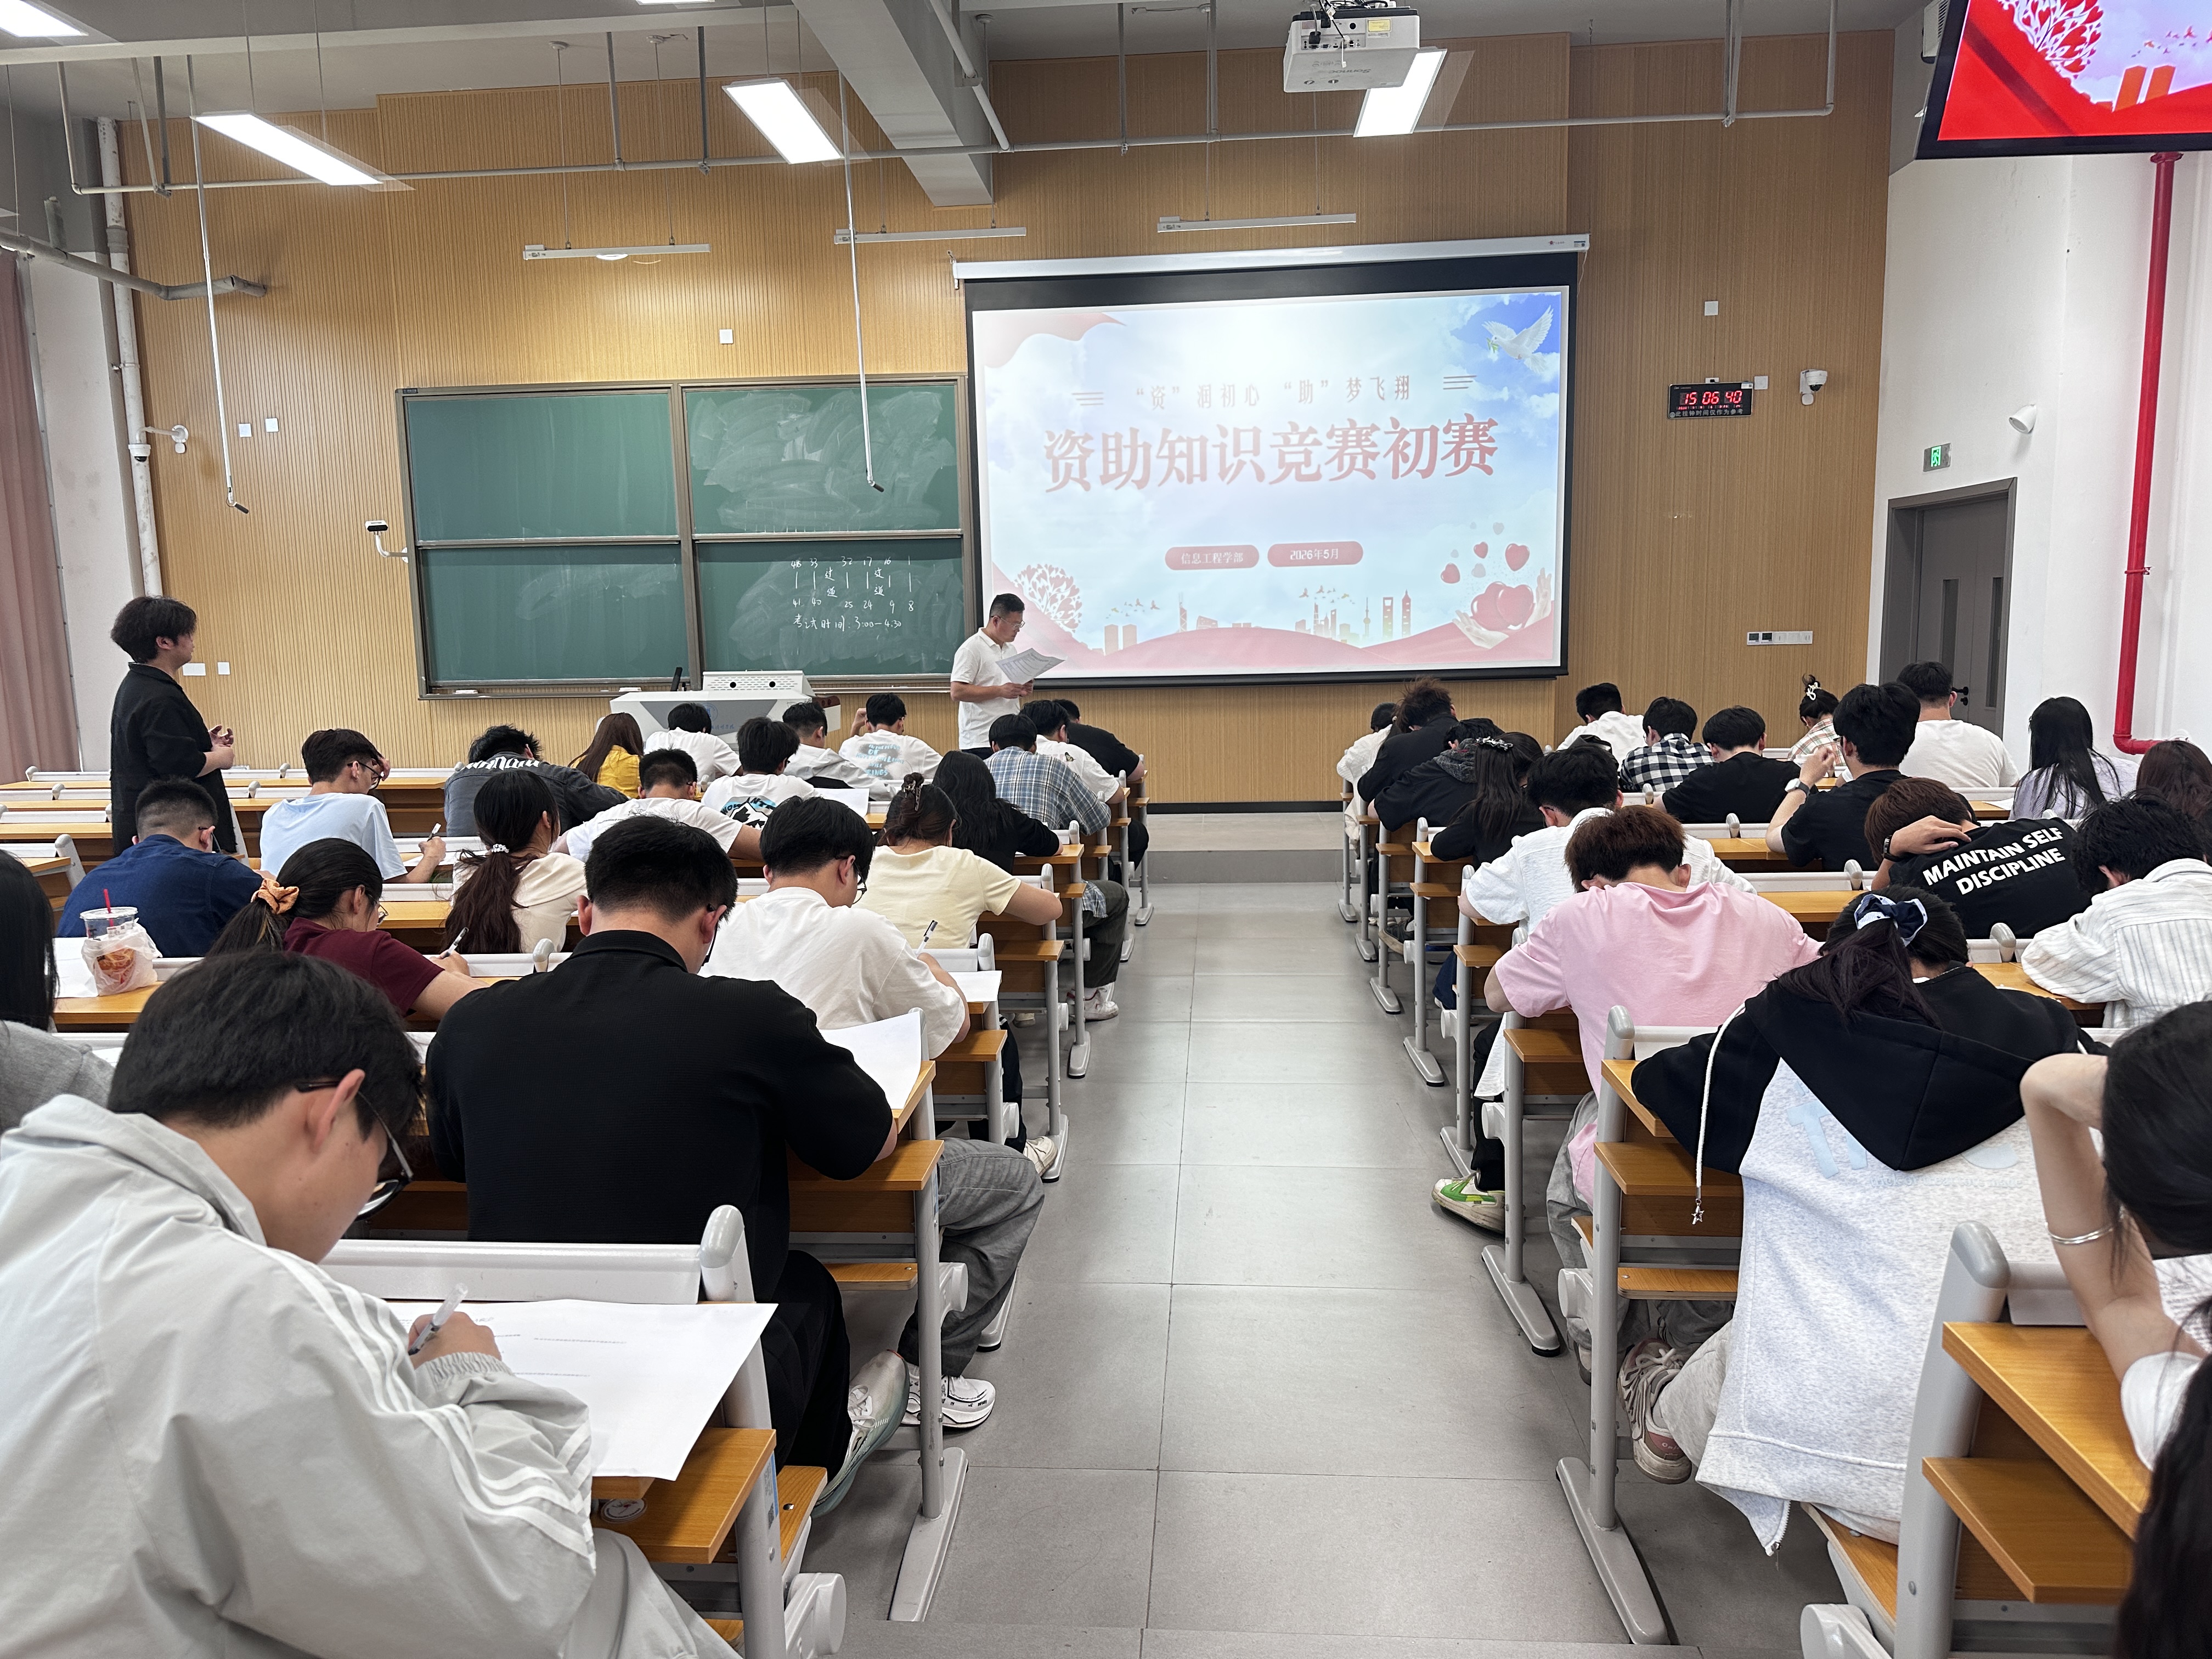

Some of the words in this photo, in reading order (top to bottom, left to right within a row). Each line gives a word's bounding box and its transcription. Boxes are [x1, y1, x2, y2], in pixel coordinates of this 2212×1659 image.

[1701, 391, 1720, 405] 06
[1725, 390, 1743, 404] 40
[1675, 409, 1743, 417] 此挂钟时间仅作为参考
[1043, 412, 1499, 494] 资助知识竞赛初赛
[809, 558, 818, 568] 33
[840, 556, 853, 567] 32
[863, 556, 873, 567] 17
[1181, 551, 1244, 565] 信息工程学部
[1290, 548, 1339, 561] 2026年5月
[812, 595, 822, 606] 40
[864, 600, 873, 610] 24
[889, 600, 895, 614] 9
[909, 600, 915, 612] 8
[1922, 845, 2025, 886] MAINTAIN
[2022, 827, 2064, 849] SELF
[1956, 847, 2066, 895] DISCIPLINE
